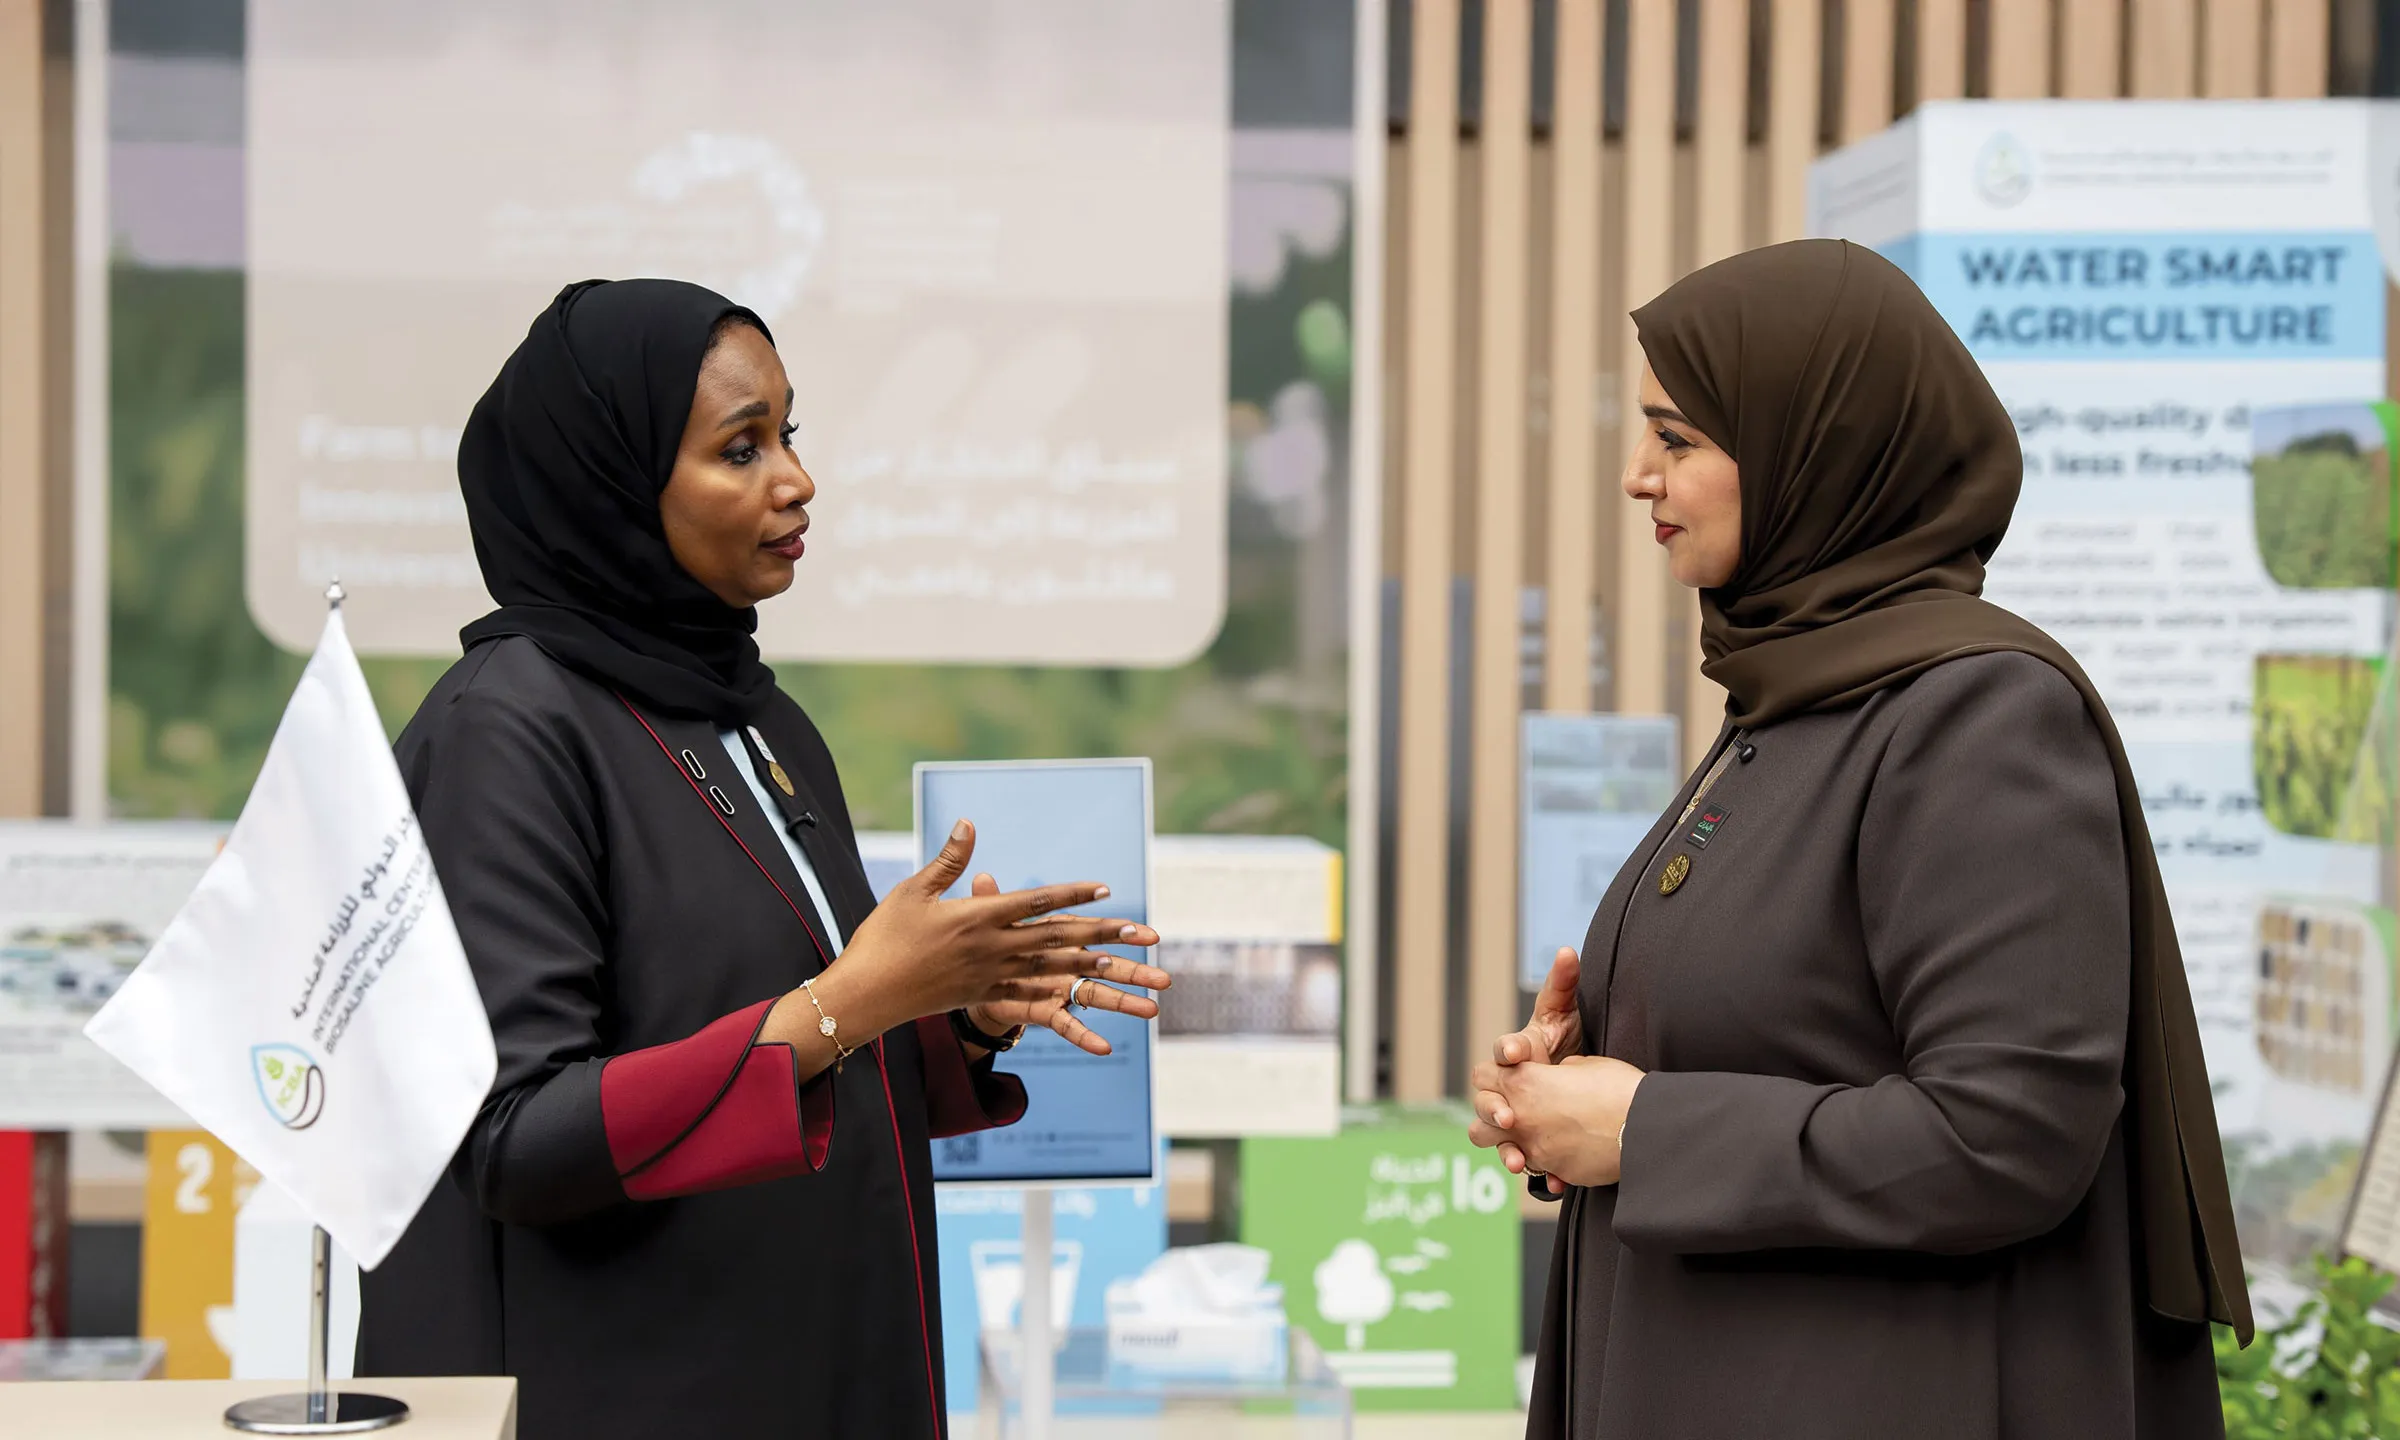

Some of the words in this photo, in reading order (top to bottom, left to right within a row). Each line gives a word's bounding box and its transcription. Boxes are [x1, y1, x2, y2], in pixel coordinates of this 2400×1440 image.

[1961, 247, 2149, 288] WATER
[2164, 246, 2346, 287] SMART
[1969, 304, 2333, 347] AGRICULTURE
[2052, 450, 2125, 477] less
[311, 917, 391, 1042] INTERNATIONAL
[323, 966, 378, 1054] BIOSALINE
[175, 1142, 214, 1214] 2
